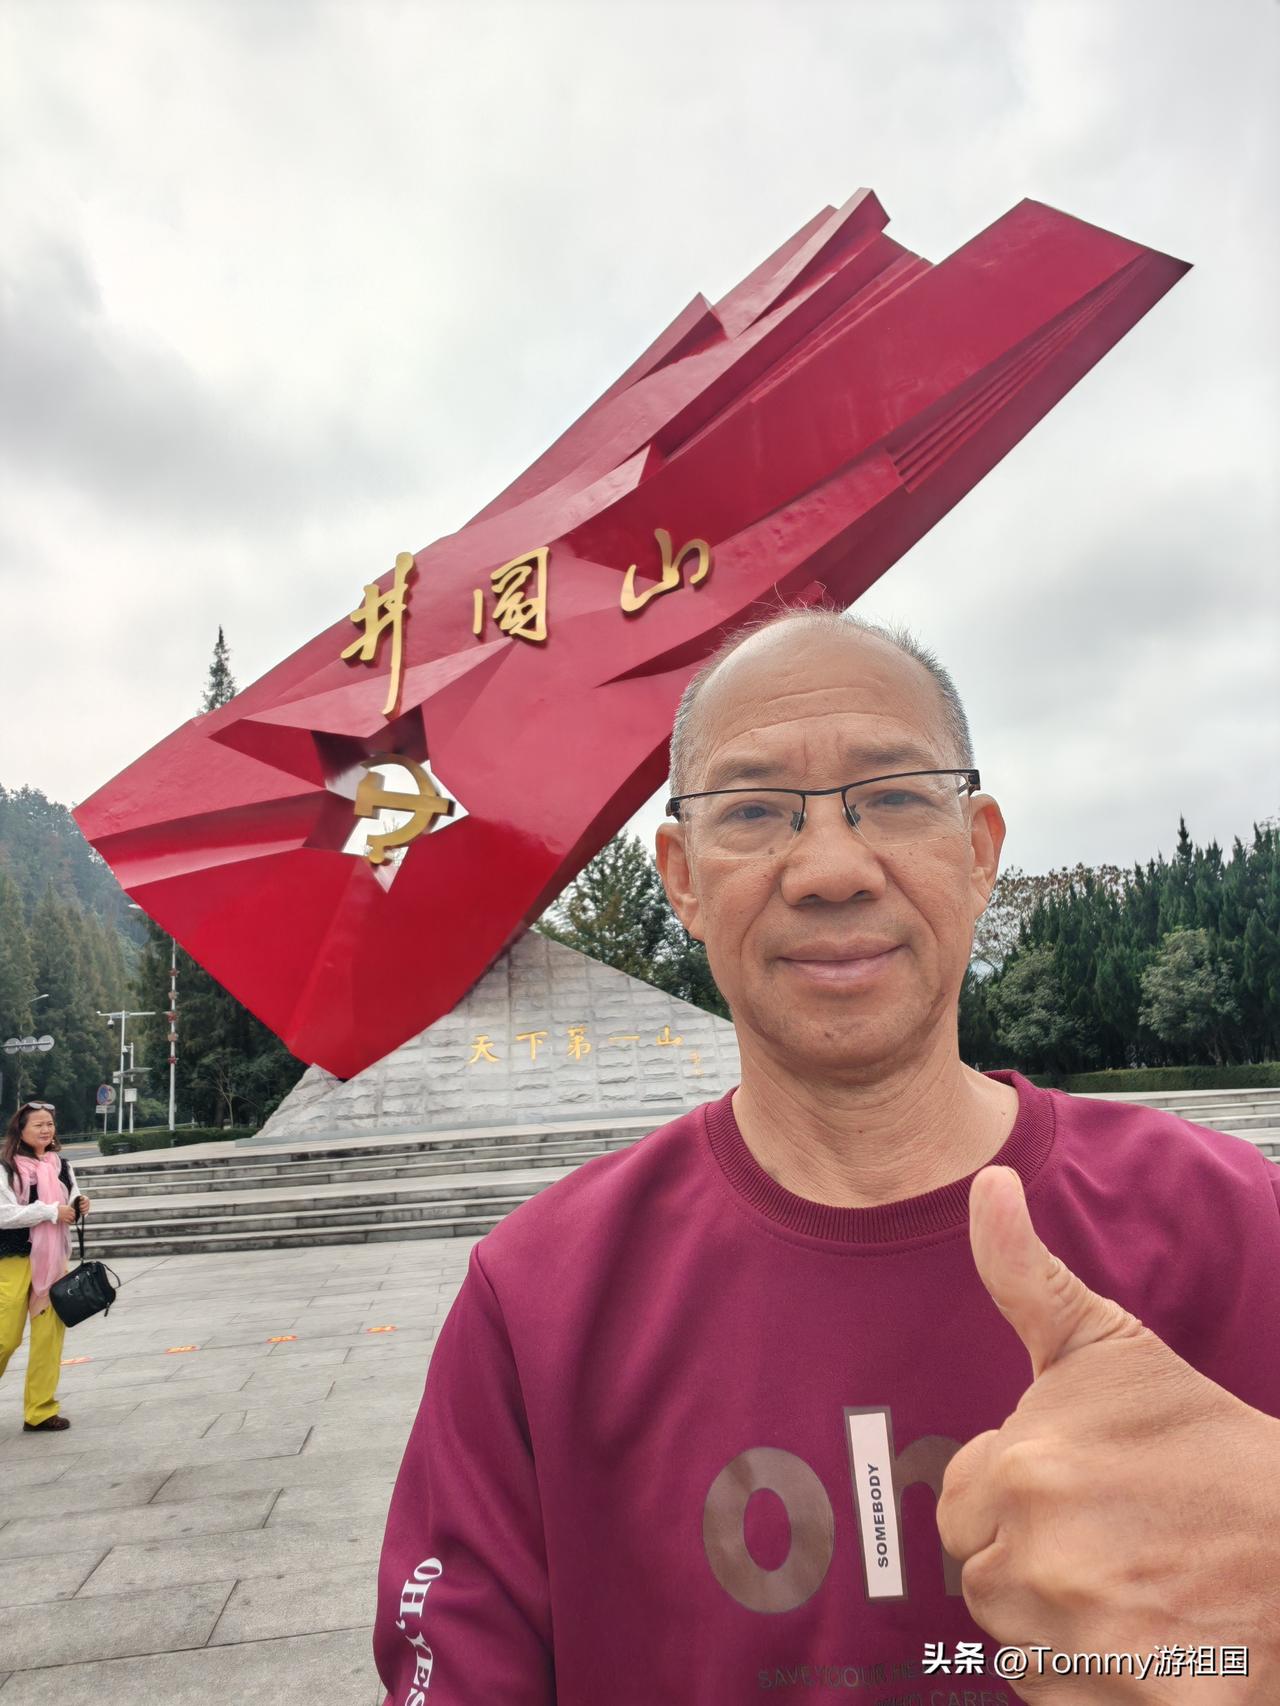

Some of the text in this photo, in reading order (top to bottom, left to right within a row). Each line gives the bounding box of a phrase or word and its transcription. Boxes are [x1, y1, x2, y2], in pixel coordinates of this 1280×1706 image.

[469, 1024, 683, 1064] 天下第一山
[867, 1464, 889, 1568] SOMEBODY
[396, 1557, 442, 1630] OH,
